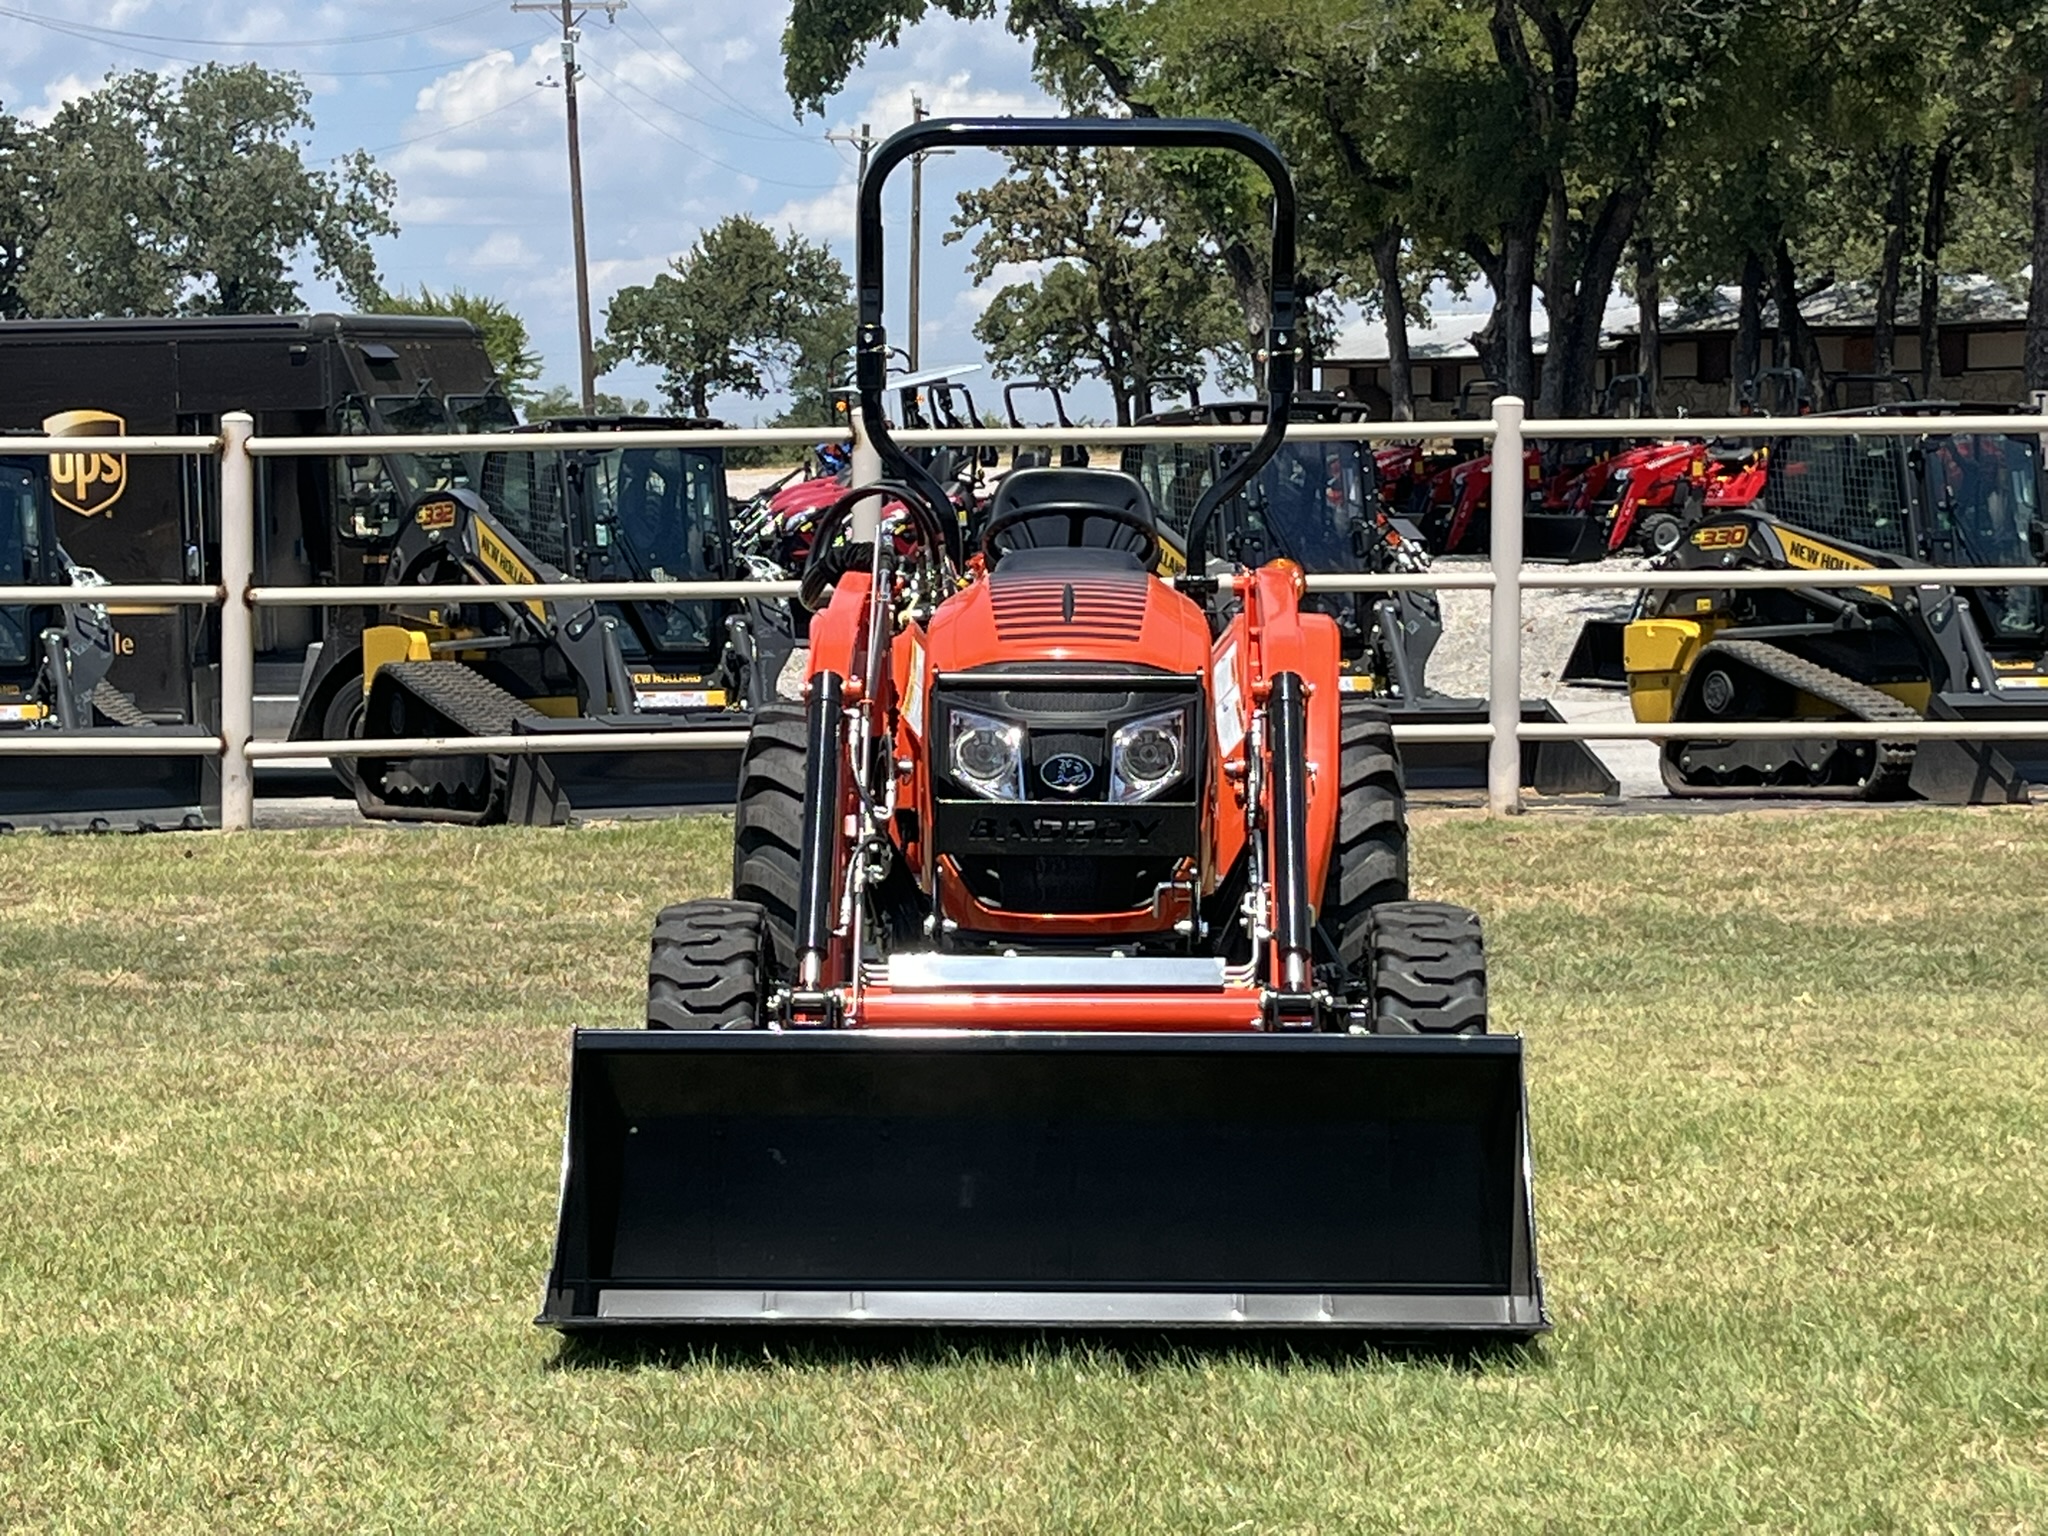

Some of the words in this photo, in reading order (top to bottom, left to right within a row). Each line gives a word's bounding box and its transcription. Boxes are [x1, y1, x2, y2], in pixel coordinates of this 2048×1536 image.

[49, 452, 121, 500] ups
[481, 533, 501, 563] NEW
[500, 551, 533, 585] HOLLA
[1789, 540, 1820, 565] NEW
